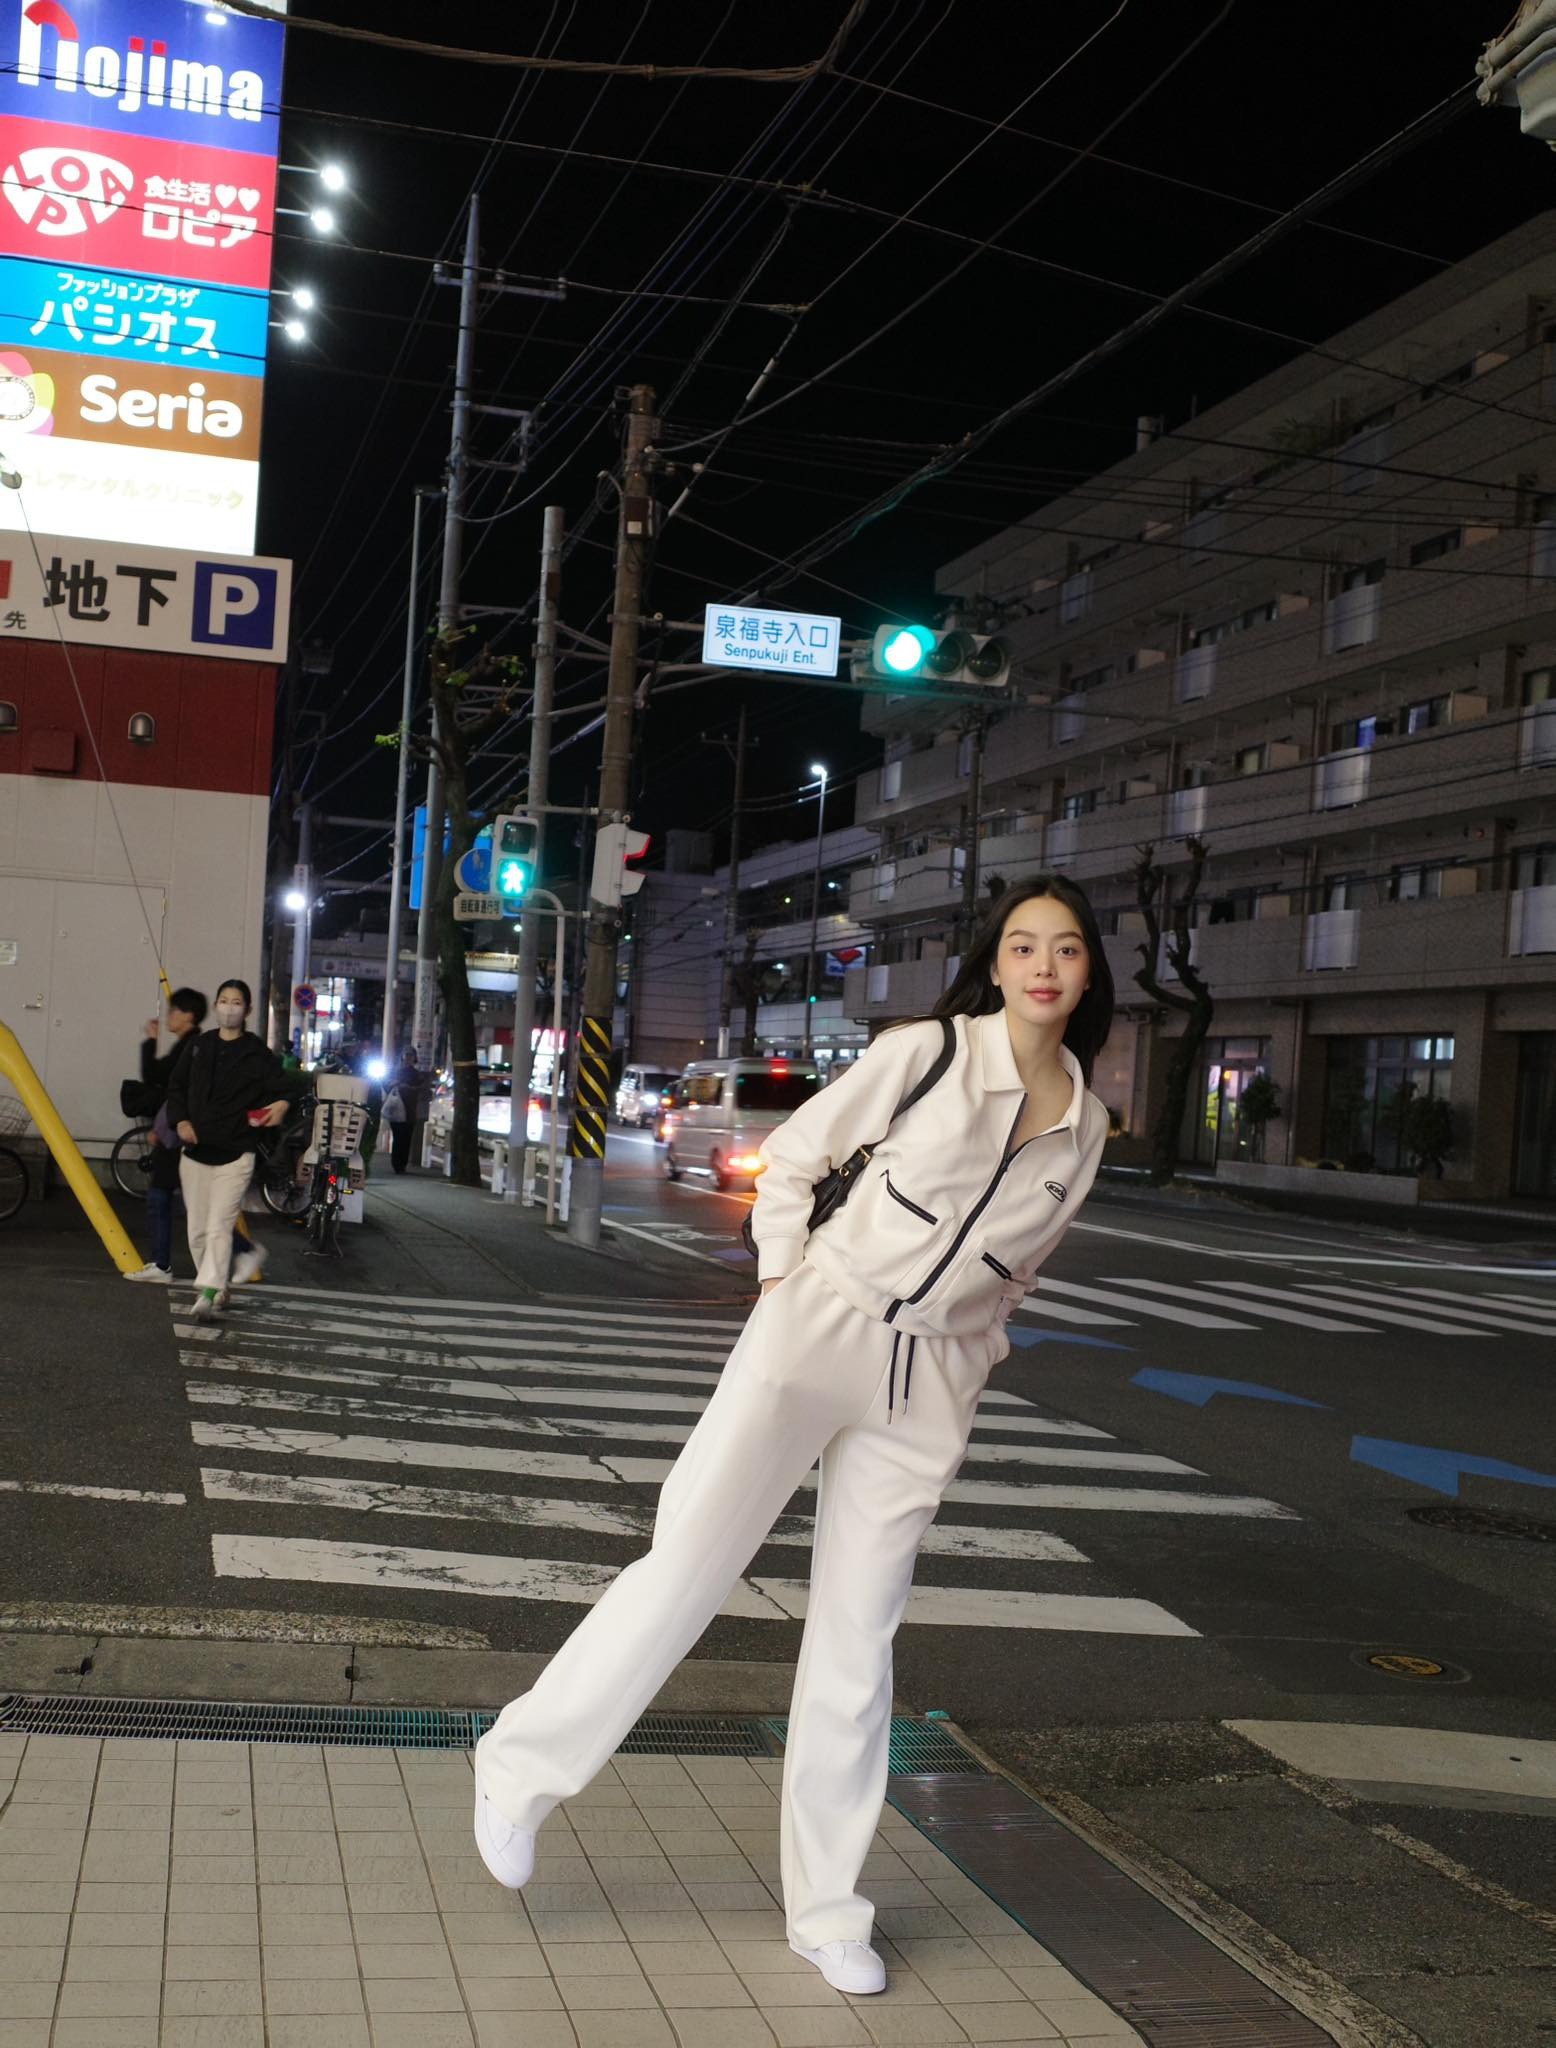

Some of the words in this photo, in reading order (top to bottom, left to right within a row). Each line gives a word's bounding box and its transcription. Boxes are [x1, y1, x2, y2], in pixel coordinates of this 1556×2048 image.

[17, 0, 264, 122] nojima
[142, 202, 258, 248] ロピア
[56, 271, 201, 308] ファッションプラザ
[29, 295, 221, 360] パシオス
[79, 374, 244, 438] Seria
[43, 556, 178, 627] 地下
[207, 572, 260, 636] P
[714, 614, 830, 649] 泉福寺入口
[723, 642, 789, 665] Senpukuji
[792, 650, 818, 665] Ent.
